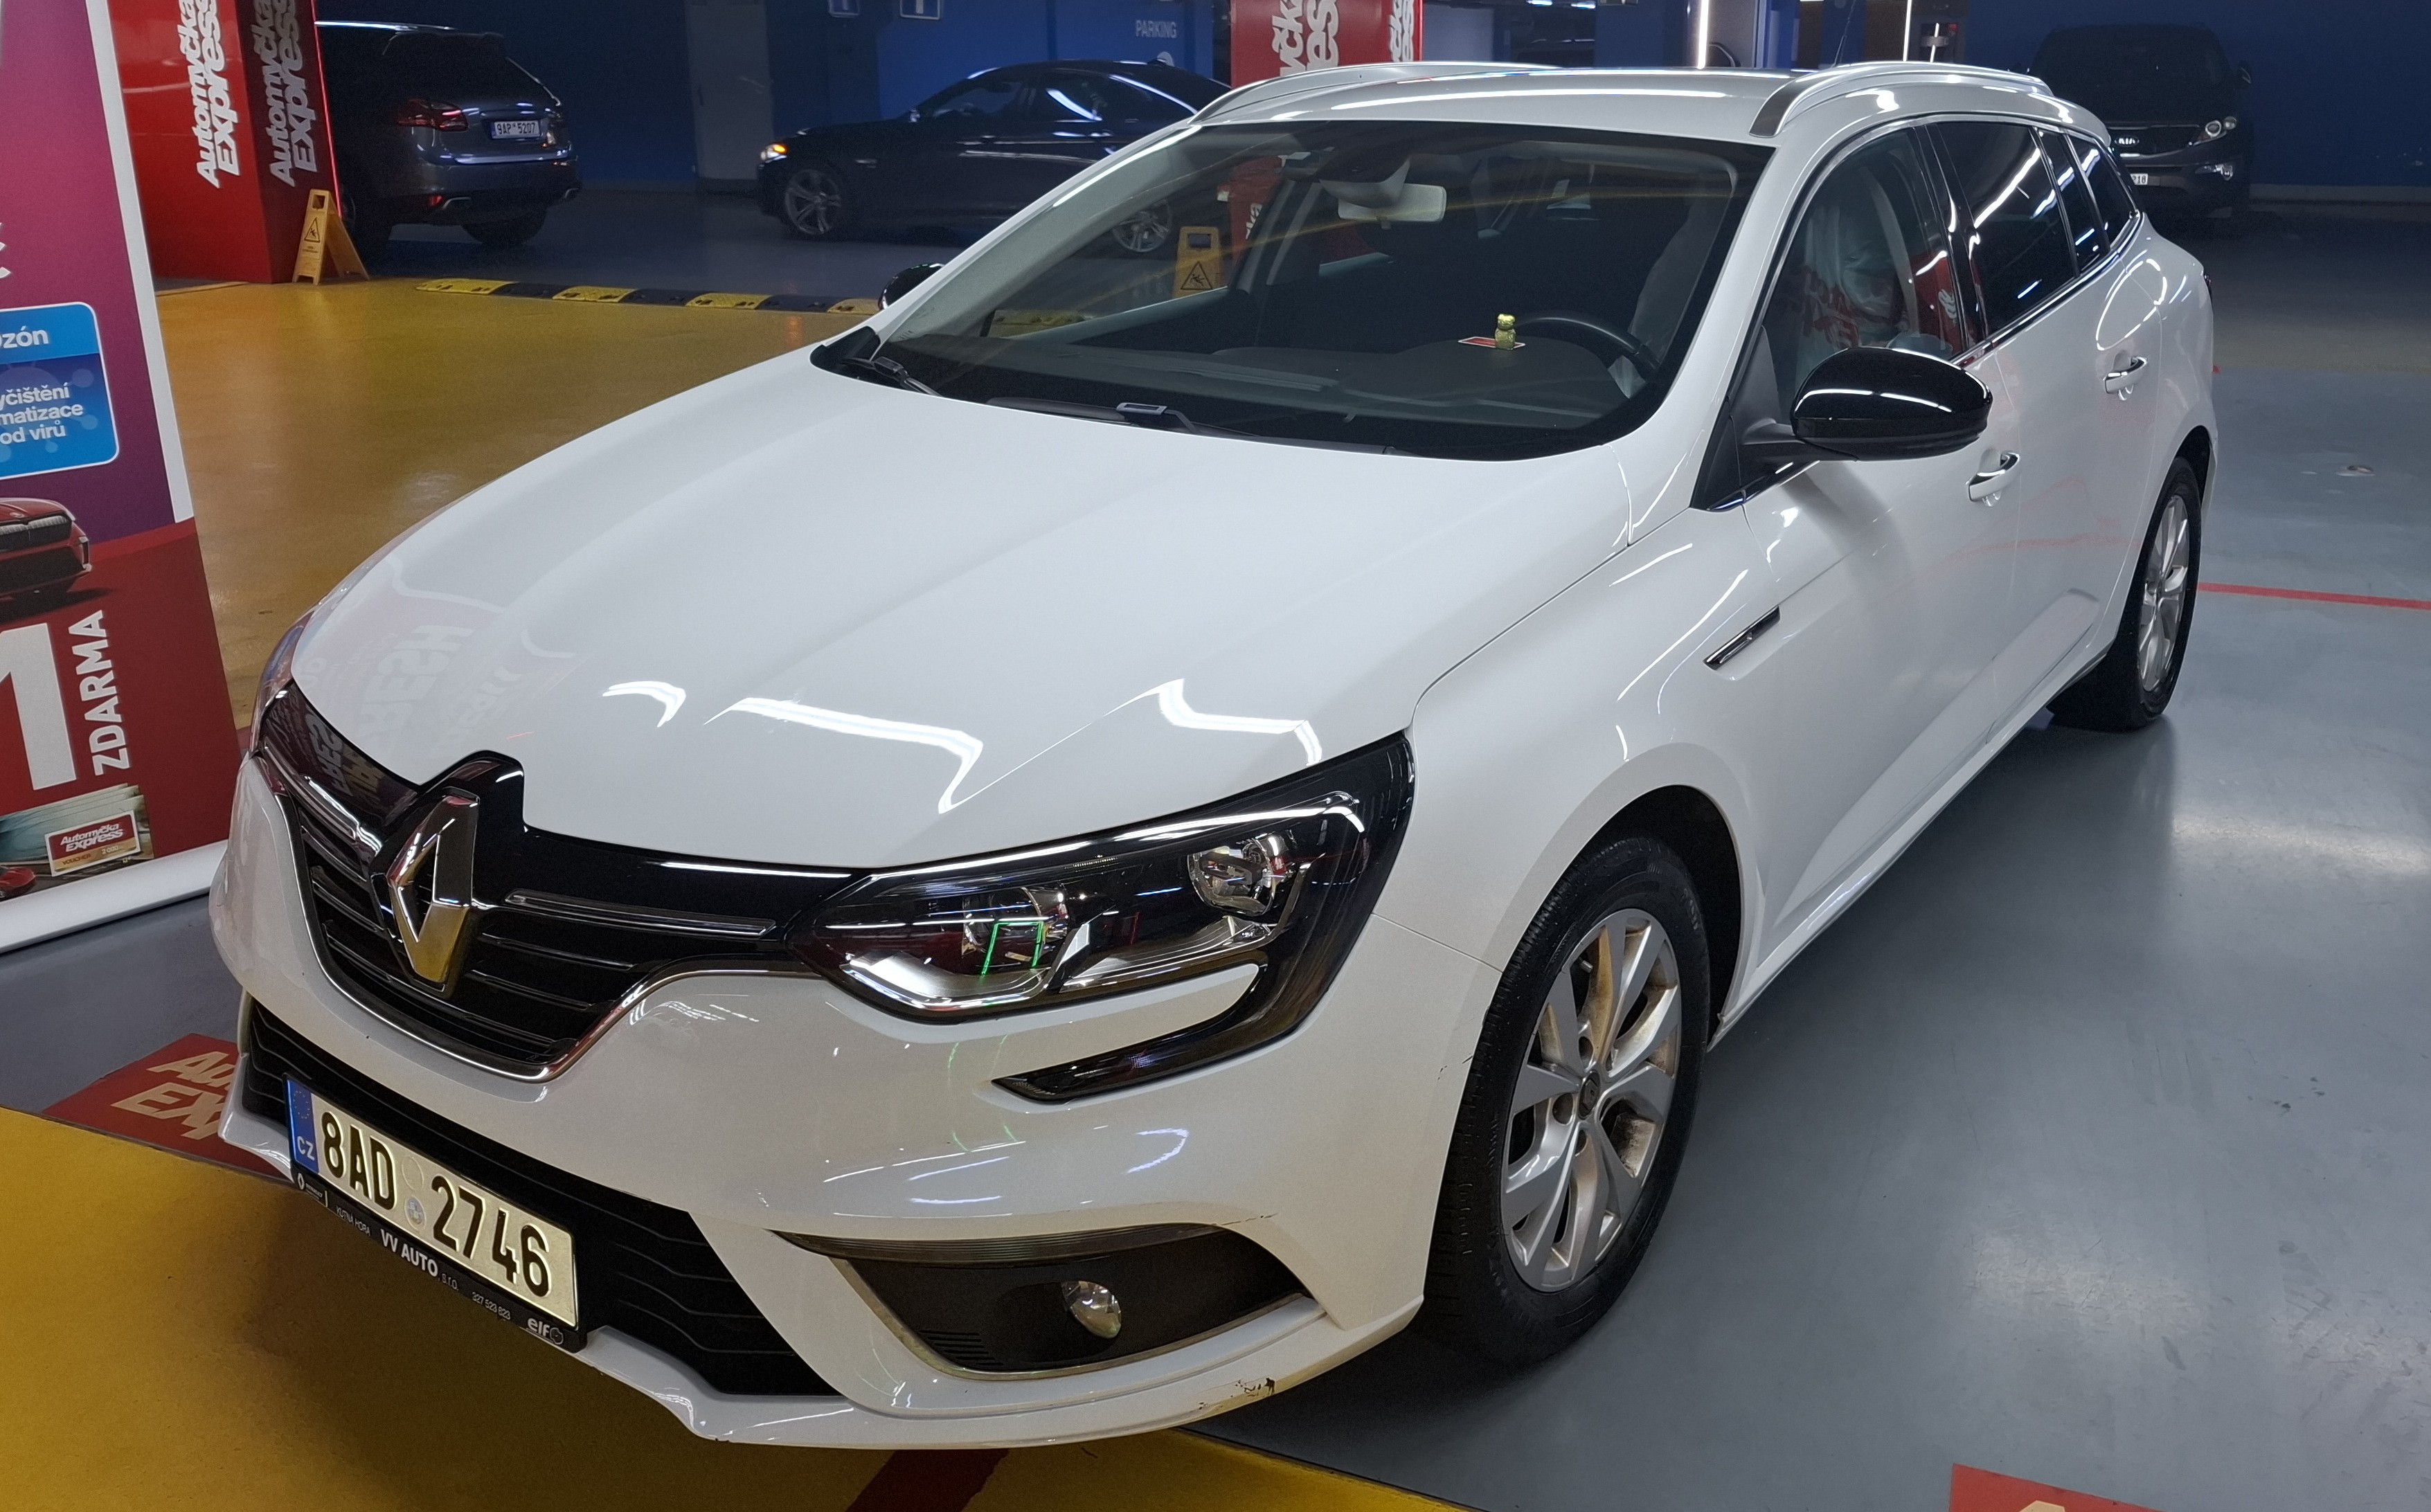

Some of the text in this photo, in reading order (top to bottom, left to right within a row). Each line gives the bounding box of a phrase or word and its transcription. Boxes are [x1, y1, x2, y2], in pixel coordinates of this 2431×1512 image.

[1136, 19, 1177, 39] PARKING
[177, 0, 219, 188] Automyčka
[251, 0, 295, 187] Automyčka
[496, 123, 512, 134] 9AP
[517, 123, 536, 134] 5207
[0, 325, 49, 348] zón
[0, 420, 66, 444] od virů
[69, 610, 130, 776] ZDARMA
[60, 823, 119, 845] Automyčka
[66, 829, 123, 852] Express
[296, 1135, 315, 1161] CZ
[321, 1111, 395, 1210] 8AD
[431, 1175, 550, 1297] 2746
[380, 1228, 398, 1252] VV
[528, 1317, 551, 1338] elf
